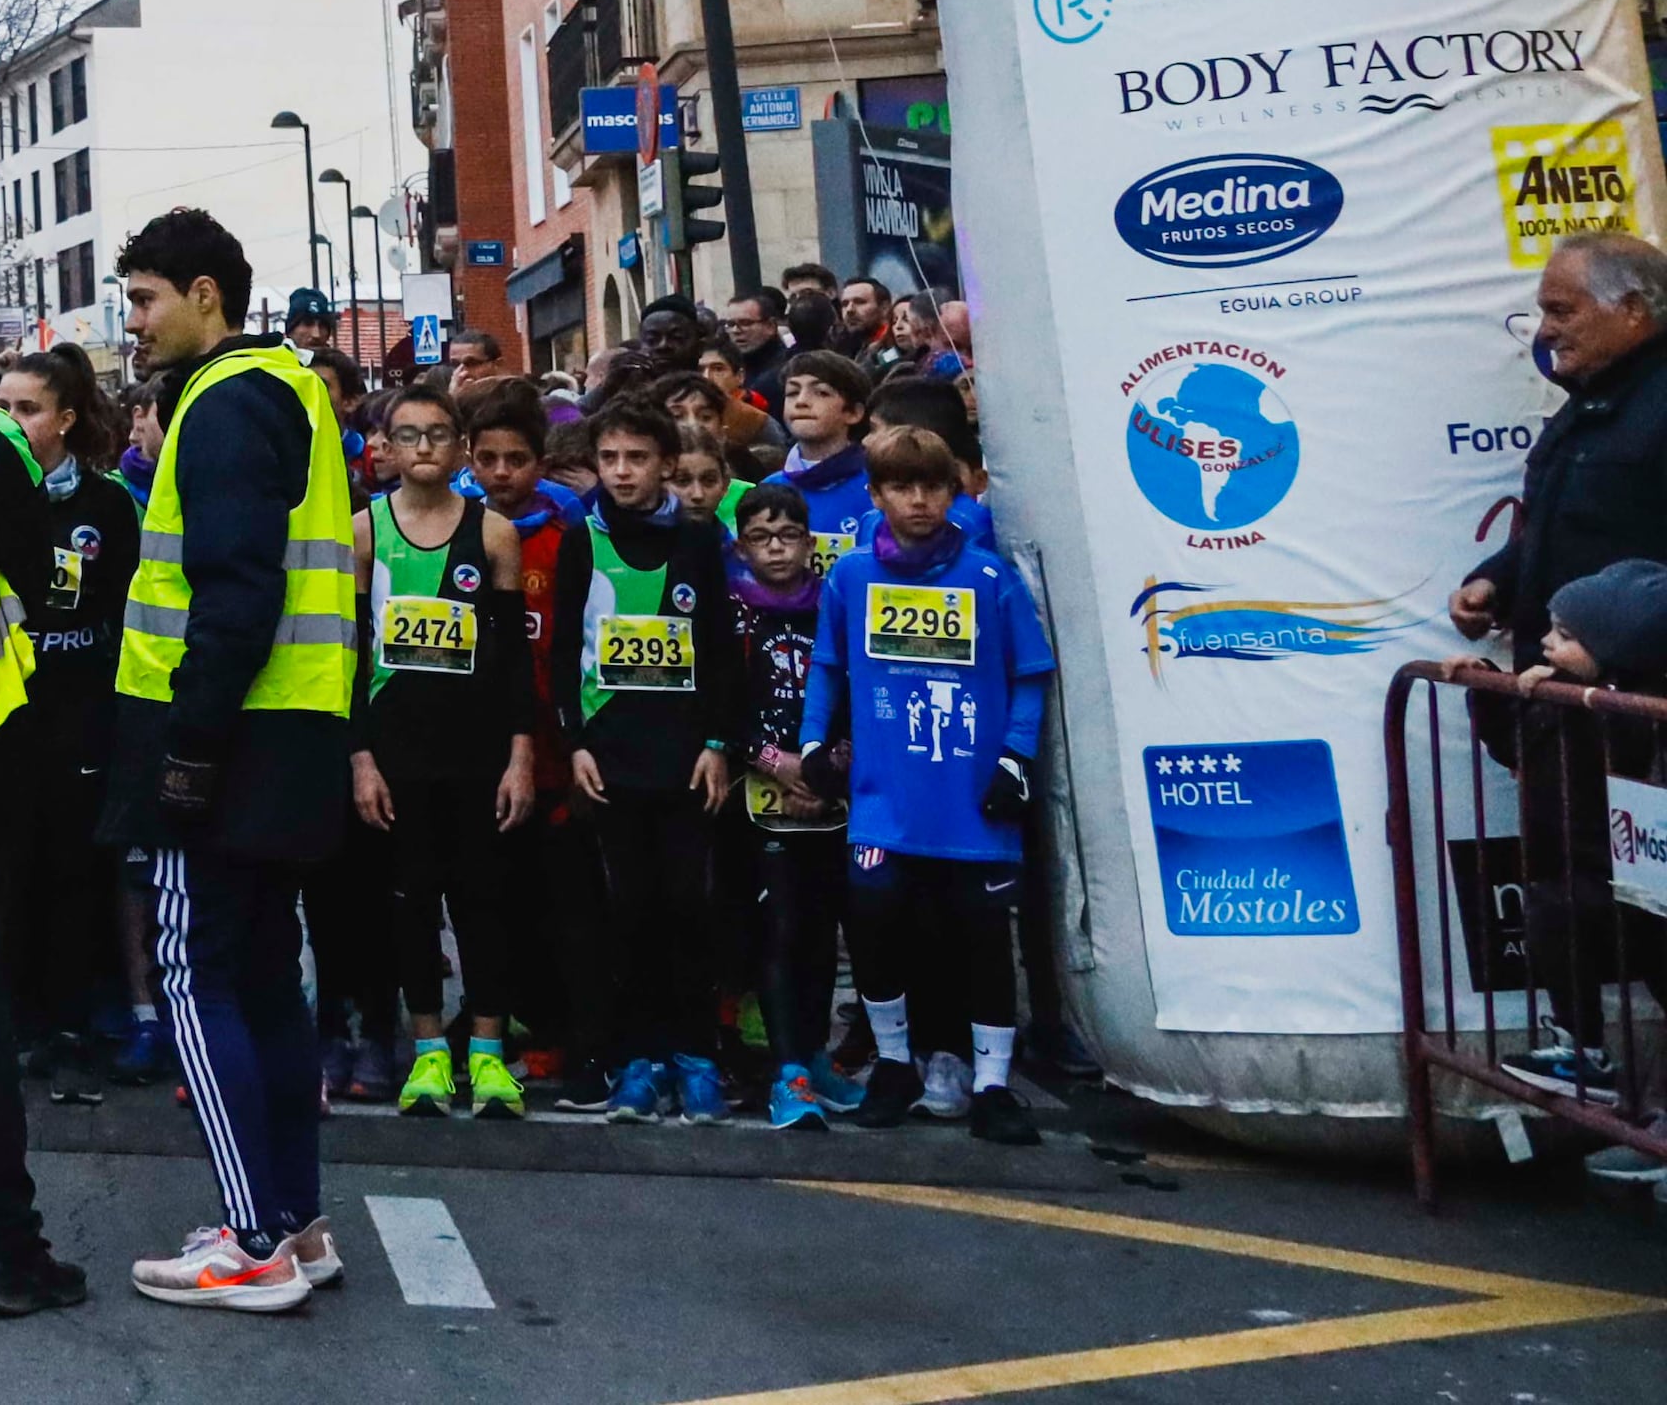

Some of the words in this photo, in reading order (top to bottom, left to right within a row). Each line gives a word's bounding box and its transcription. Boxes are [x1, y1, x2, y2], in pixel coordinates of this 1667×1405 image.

[1114, 48, 1293, 114] BODY
[1319, 29, 1585, 88] FACTORY
[749, 102, 793, 113] ANTONIO
[1165, 101, 1347, 132] WELLNESS
[1514, 156, 1626, 206] ANETO
[1140, 175, 1311, 226] Medina
[1161, 224, 1227, 245] FRUTOS
[1236, 218, 1295, 237] SECOS
[1518, 218, 1560, 238] 100%
[1288, 287, 1364, 308] GROUP
[1120, 341, 1286, 397] ALIMENTACIÓN
[1133, 411, 1238, 459] ULISES
[1447, 422, 1532, 455] Foro
[1186, 530, 1265, 551] LATINA
[393, 617, 464, 647] 2474
[880, 606, 960, 637] 2296
[608, 637, 682, 666] 2393
[1161, 781, 1253, 806] HOTEL
[1176, 869, 1255, 891] Ciudad
[1264, 868, 1291, 890] de
[1178, 889, 1346, 924] Móstoles
